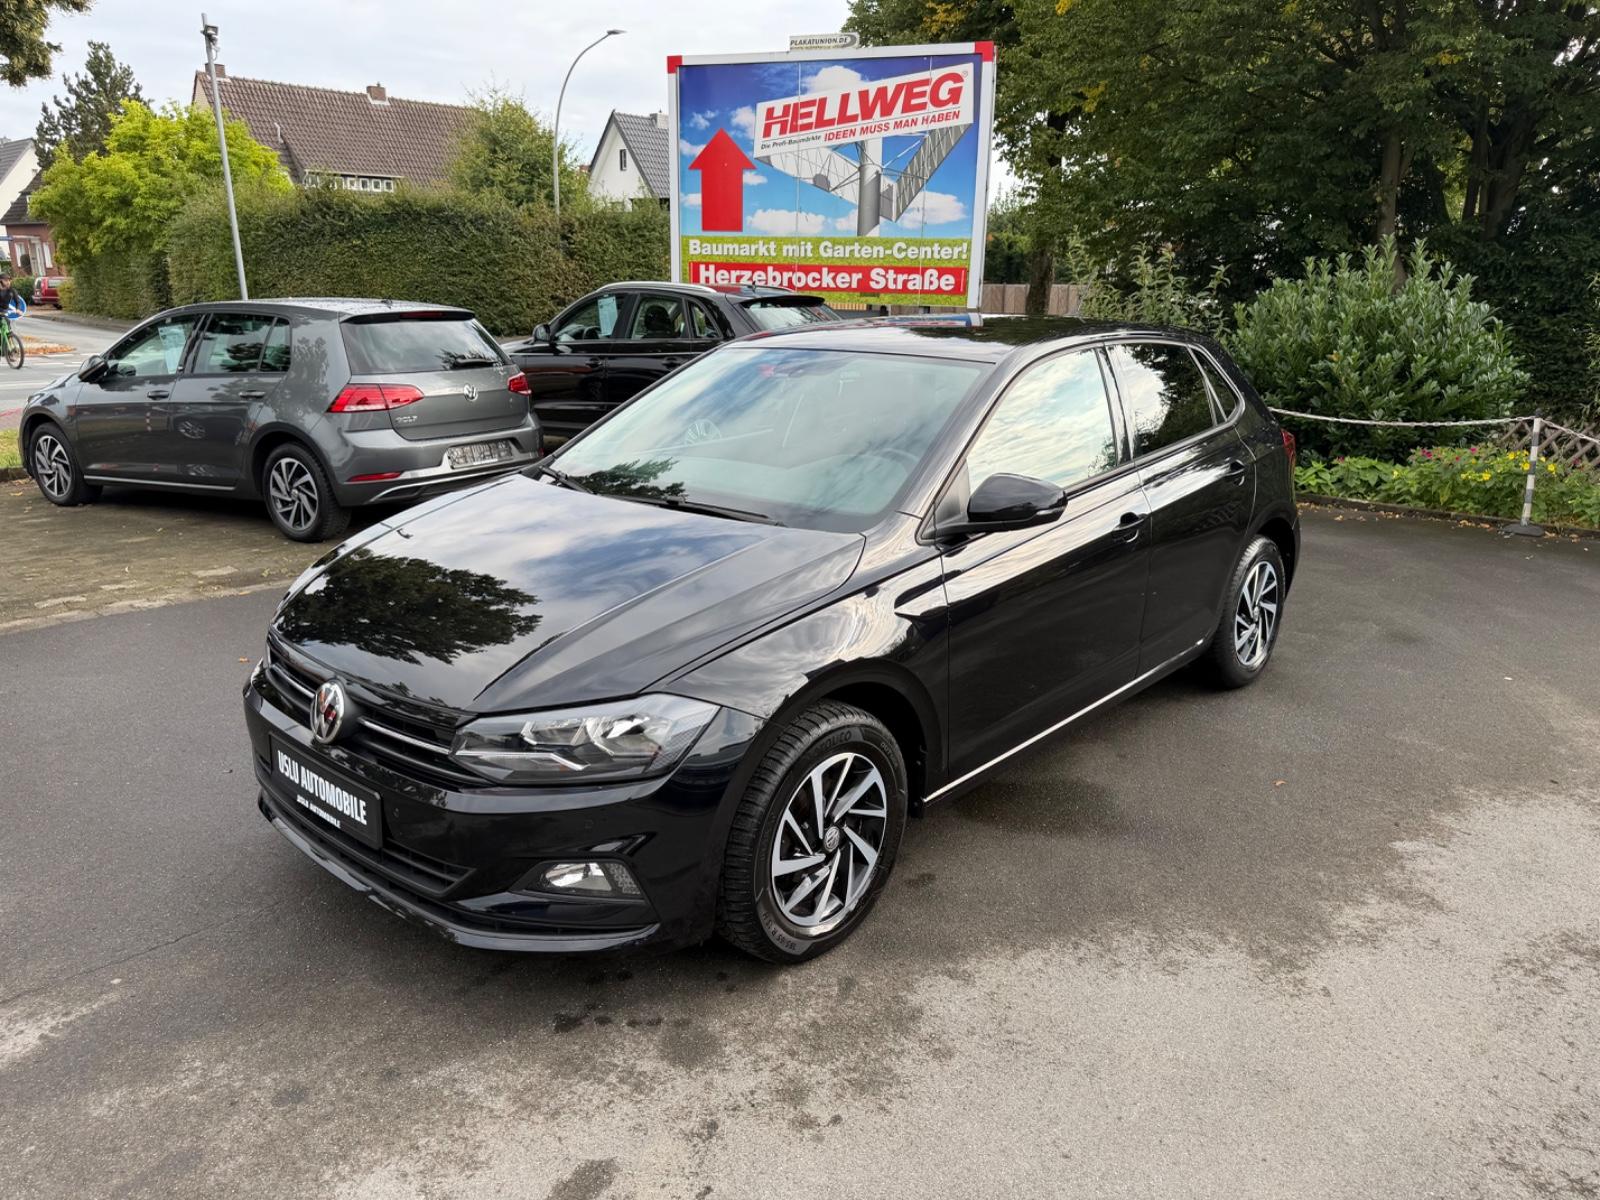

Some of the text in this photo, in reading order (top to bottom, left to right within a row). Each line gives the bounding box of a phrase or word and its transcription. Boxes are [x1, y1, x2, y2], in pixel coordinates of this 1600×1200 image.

[790, 37, 848, 46] PLAKATUNION.DE
[762, 72, 965, 138] HELLWEG
[823, 110, 960, 142] IDEEN MUSS MAN HABEN
[688, 240, 968, 260] Baumarkt mit Garten-Center!
[699, 264, 955, 291] Herzebrocker Straße
[278, 750, 367, 825] USLU AUTOMOBILE
